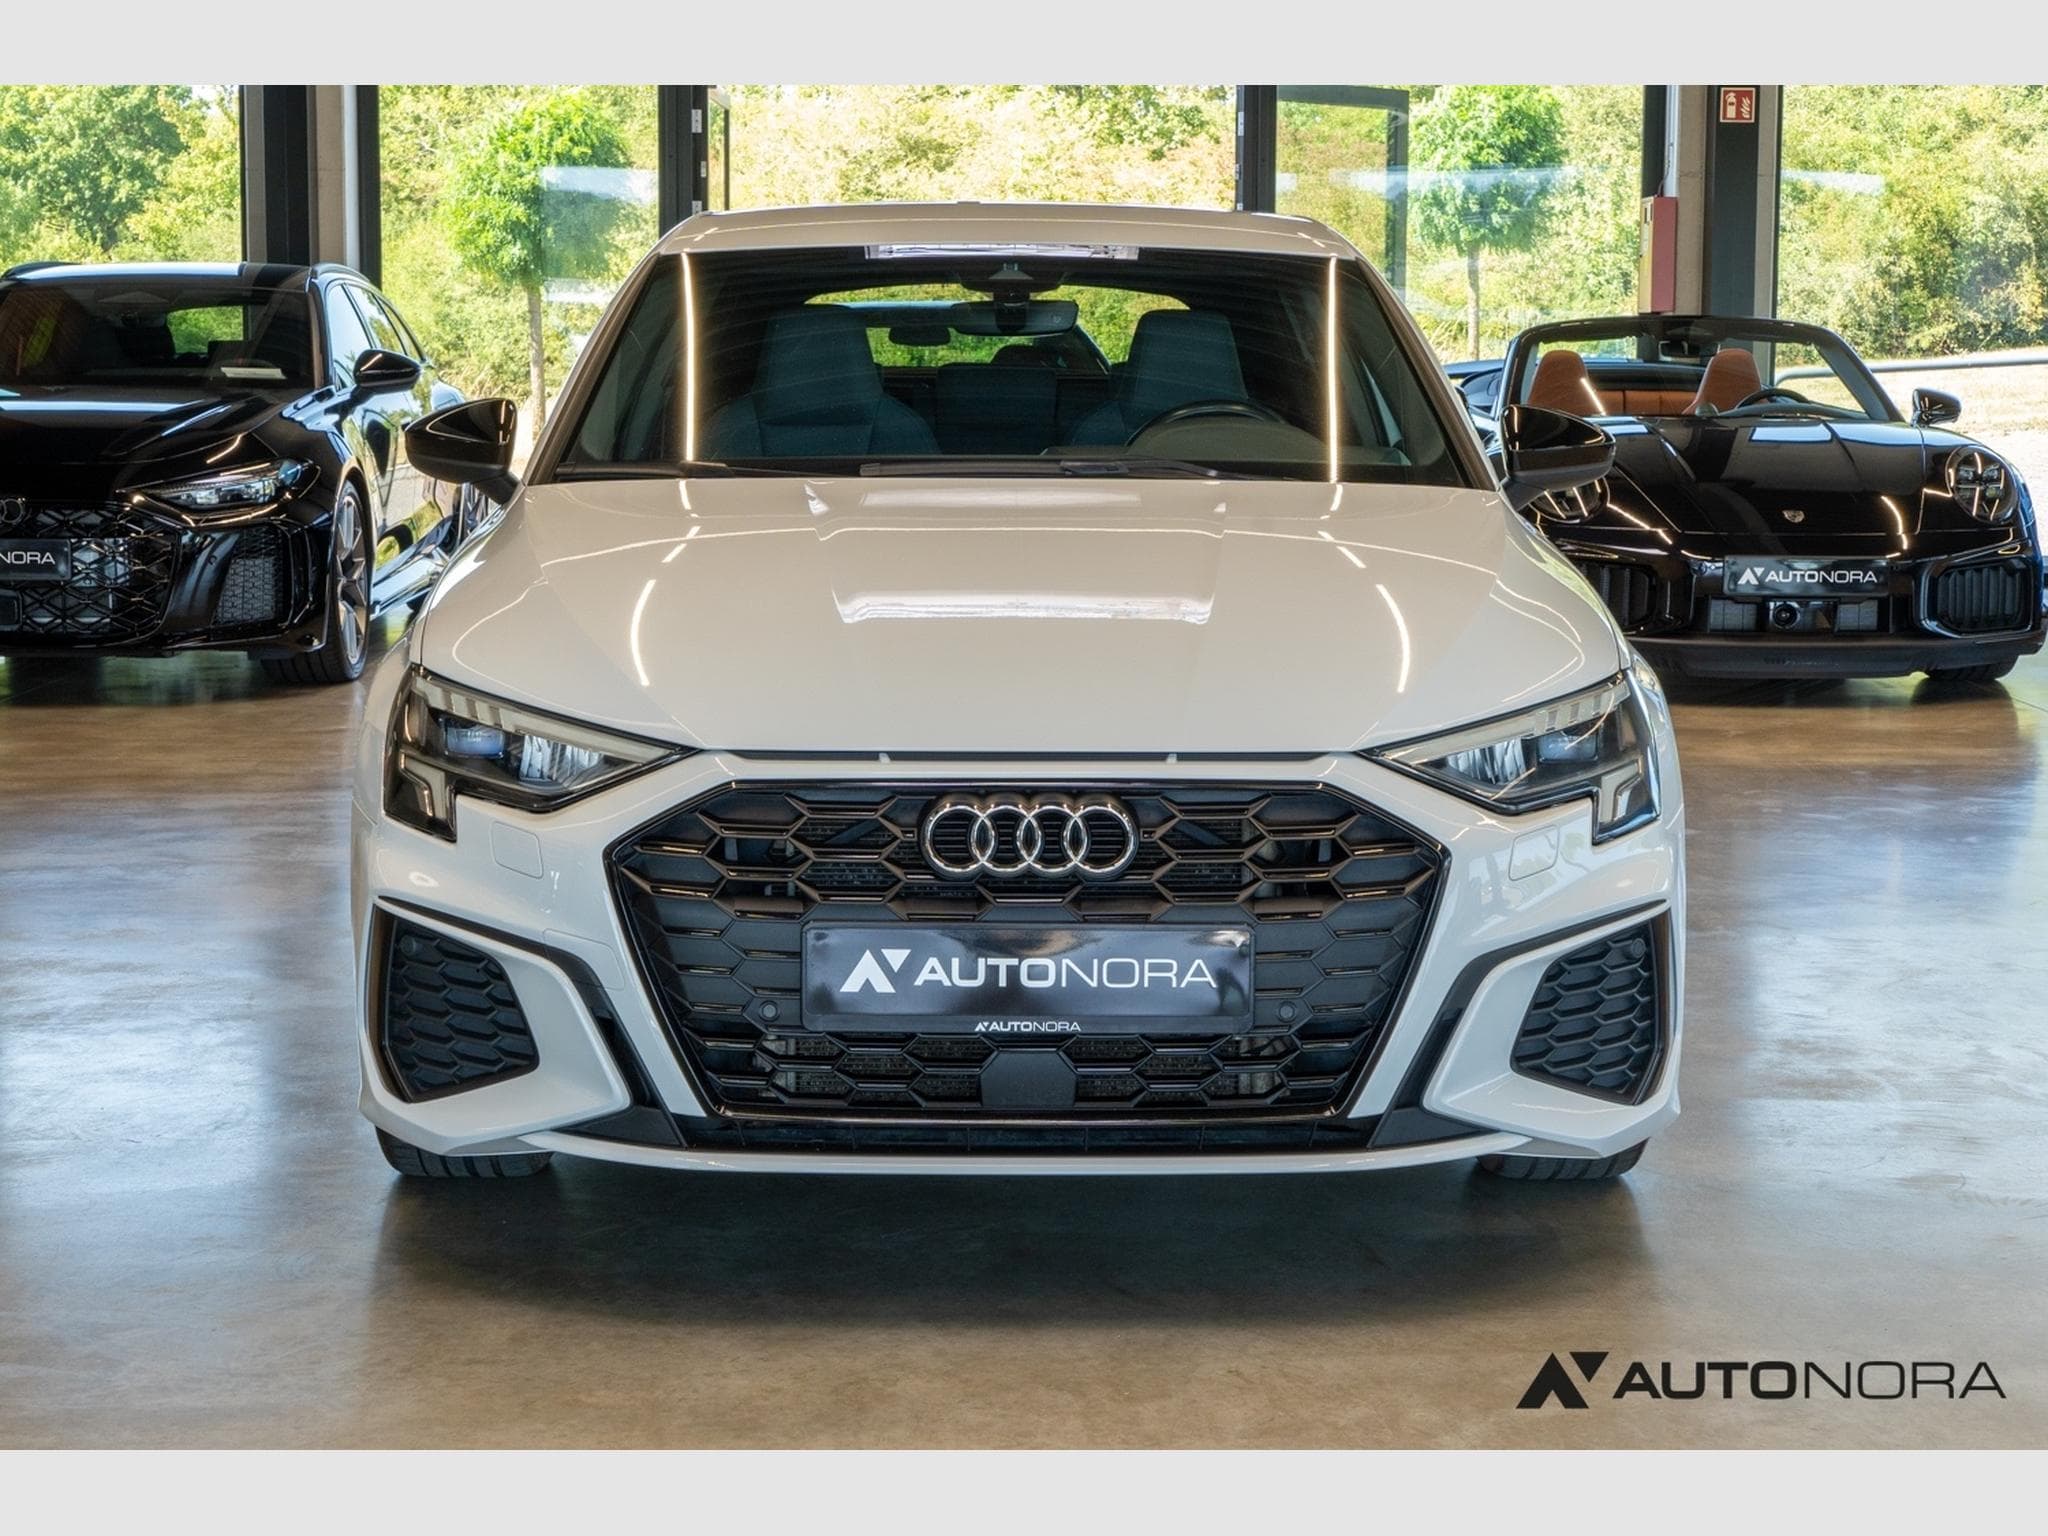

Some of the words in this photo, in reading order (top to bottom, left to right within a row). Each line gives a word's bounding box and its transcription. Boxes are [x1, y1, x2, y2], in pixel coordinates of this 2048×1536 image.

[1765, 570, 1878, 583] AUTONORA
[913, 956, 1217, 988] AUTONORA
[988, 1021, 1082, 1032] AUTONORA
